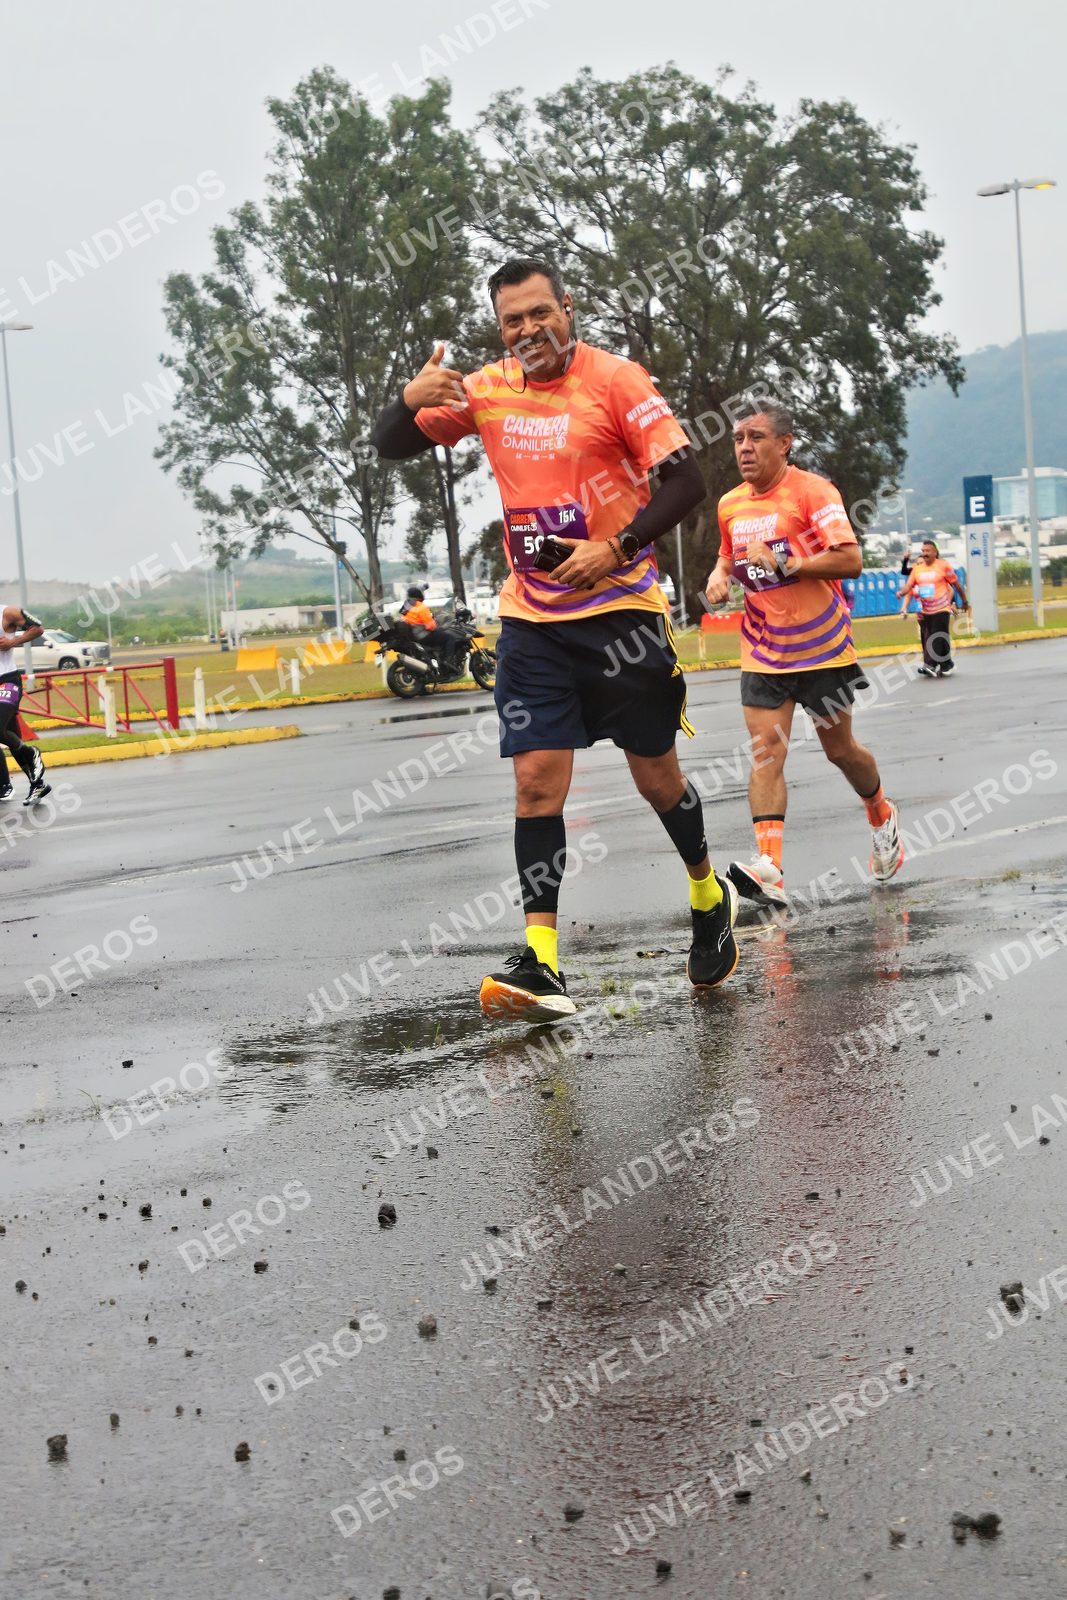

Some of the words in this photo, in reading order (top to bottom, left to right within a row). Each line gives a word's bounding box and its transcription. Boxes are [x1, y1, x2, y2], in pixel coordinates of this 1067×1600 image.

[503, 413, 570, 436] CARRERA
[502, 435, 554, 451] OMNILIFE
[969, 495, 986, 518] E
[733, 512, 779, 534] CARRERA
[0, 690, 12, 698] 72
